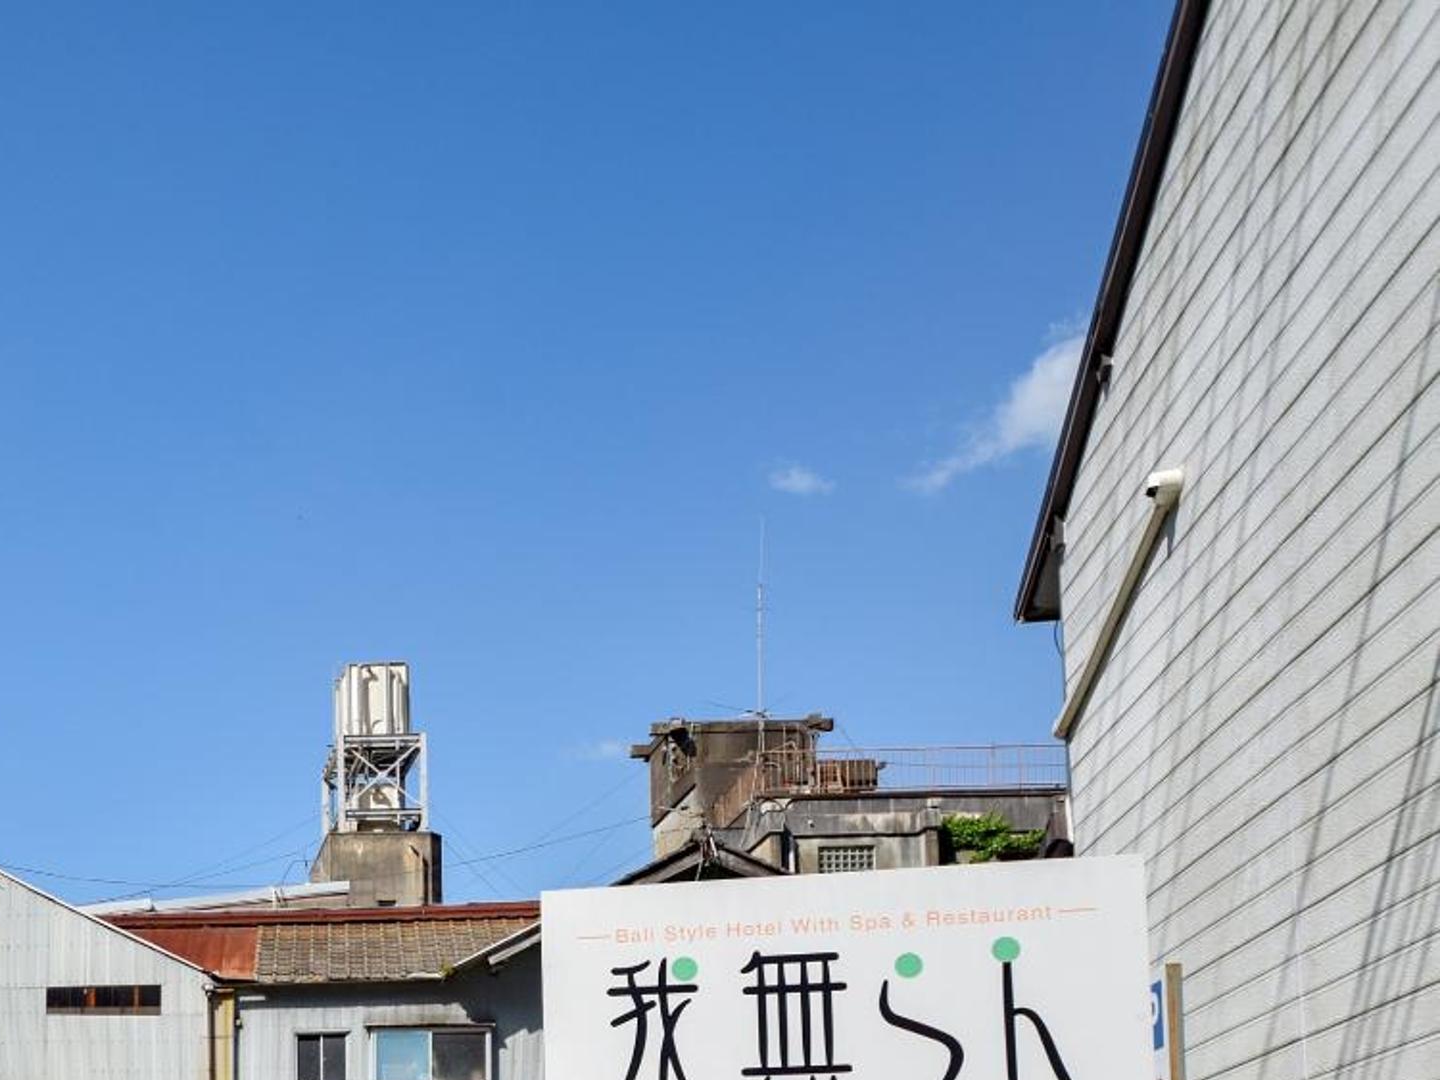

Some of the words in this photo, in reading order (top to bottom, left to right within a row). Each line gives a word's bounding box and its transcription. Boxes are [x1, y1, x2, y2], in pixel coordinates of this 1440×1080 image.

[615, 926, 654, 943] Bali
[664, 923, 718, 944] Style
[727, 920, 782, 937] Hotel
[791, 917, 840, 934] With
[850, 911, 891, 932] Spa
[901, 912, 917, 928] &
[926, 905, 1053, 927] Restaurant
